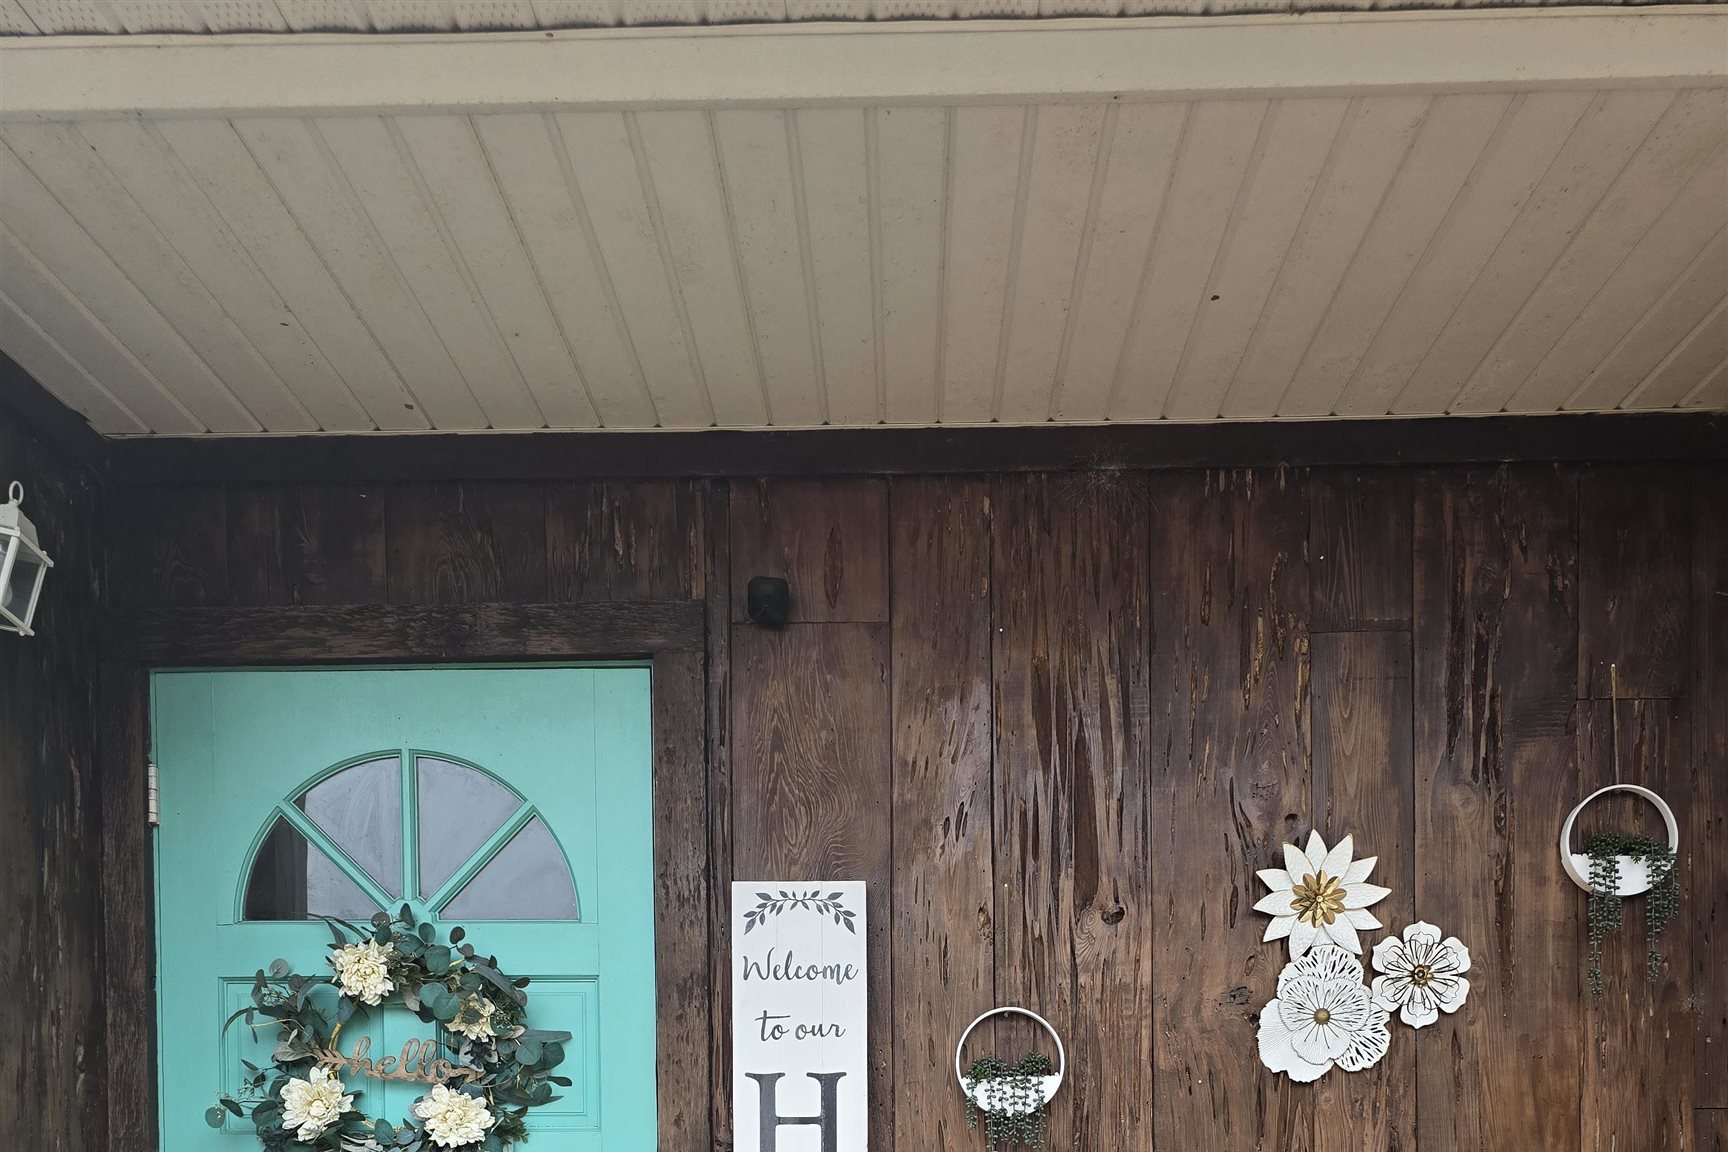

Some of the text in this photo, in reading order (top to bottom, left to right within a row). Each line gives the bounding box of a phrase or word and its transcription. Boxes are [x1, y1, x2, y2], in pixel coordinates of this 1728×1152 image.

[742, 946, 859, 985] Welcome
[754, 1010, 846, 1041] to our
[350, 1036, 452, 1084] hello
